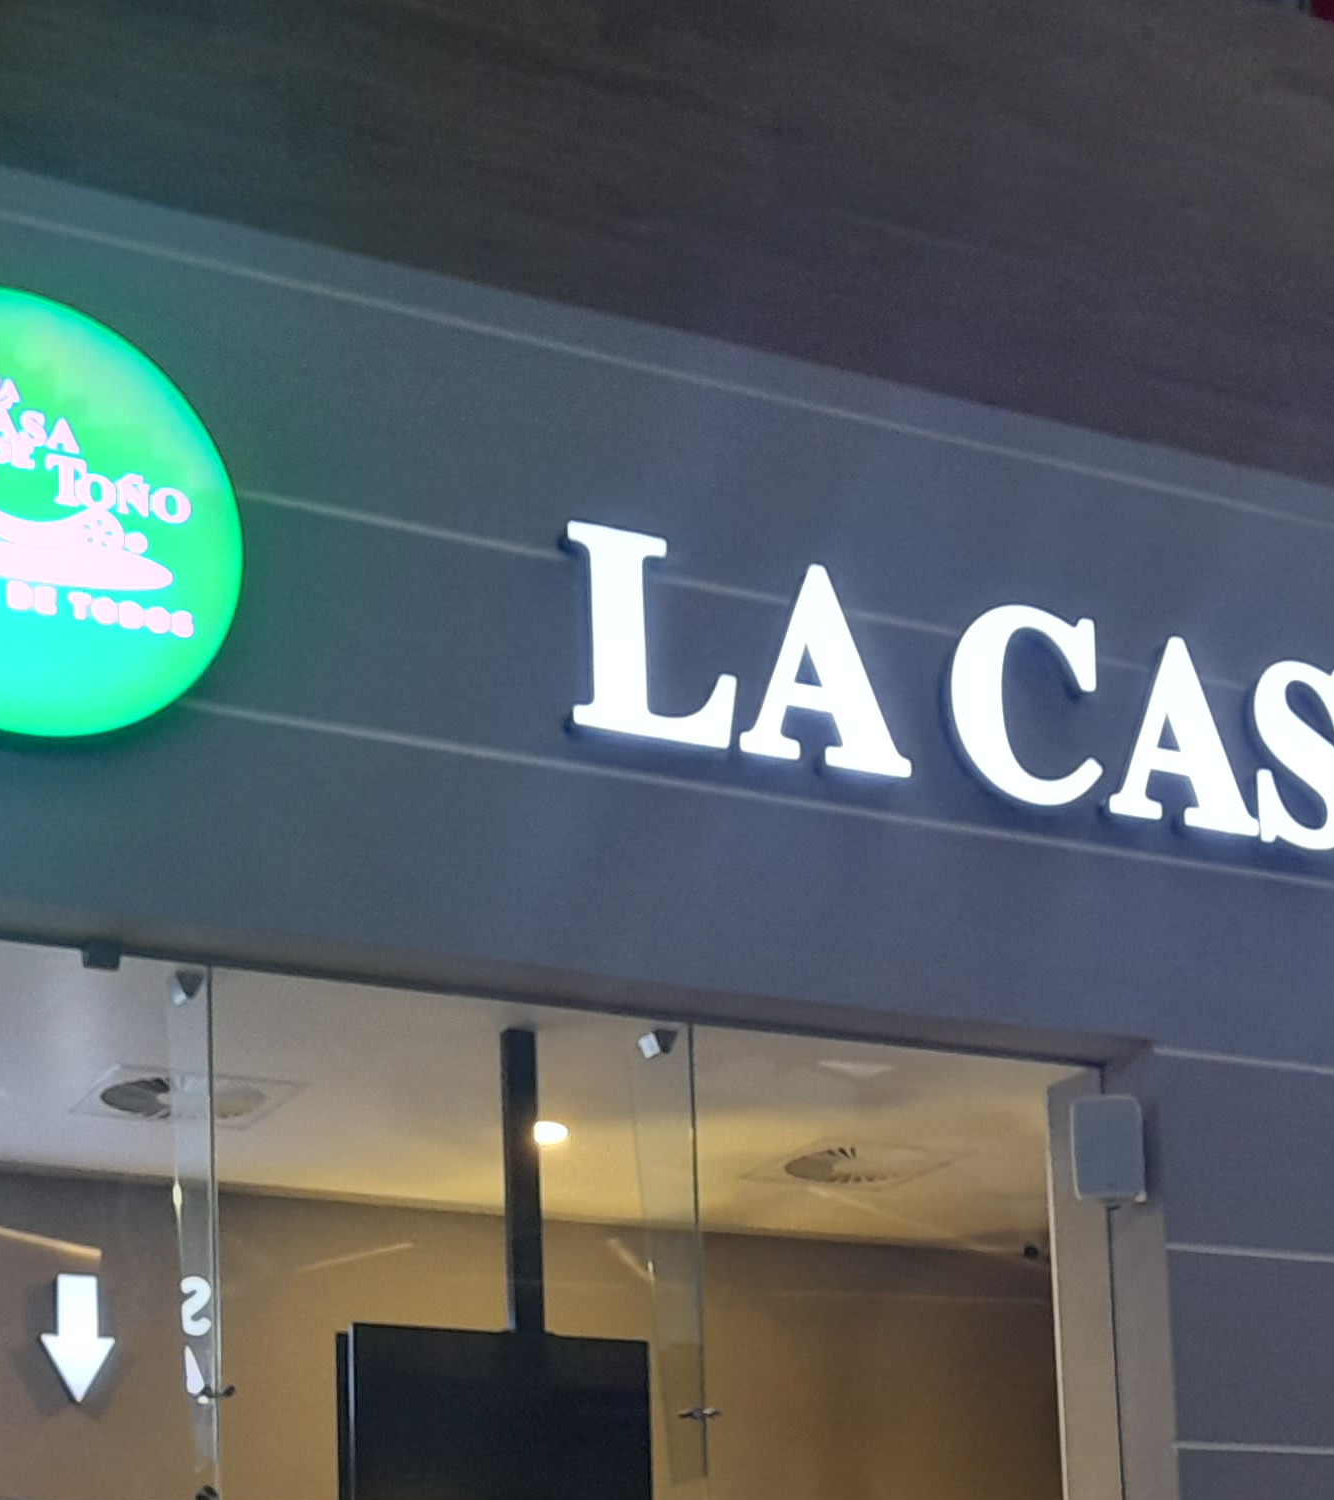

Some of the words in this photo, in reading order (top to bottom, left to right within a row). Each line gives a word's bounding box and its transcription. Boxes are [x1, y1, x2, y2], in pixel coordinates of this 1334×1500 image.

[46, 454, 192, 524] TOÑO
[6, 580, 58, 615] DE
[68, 592, 194, 638] TODOS
[566, 519, 912, 778] LA
